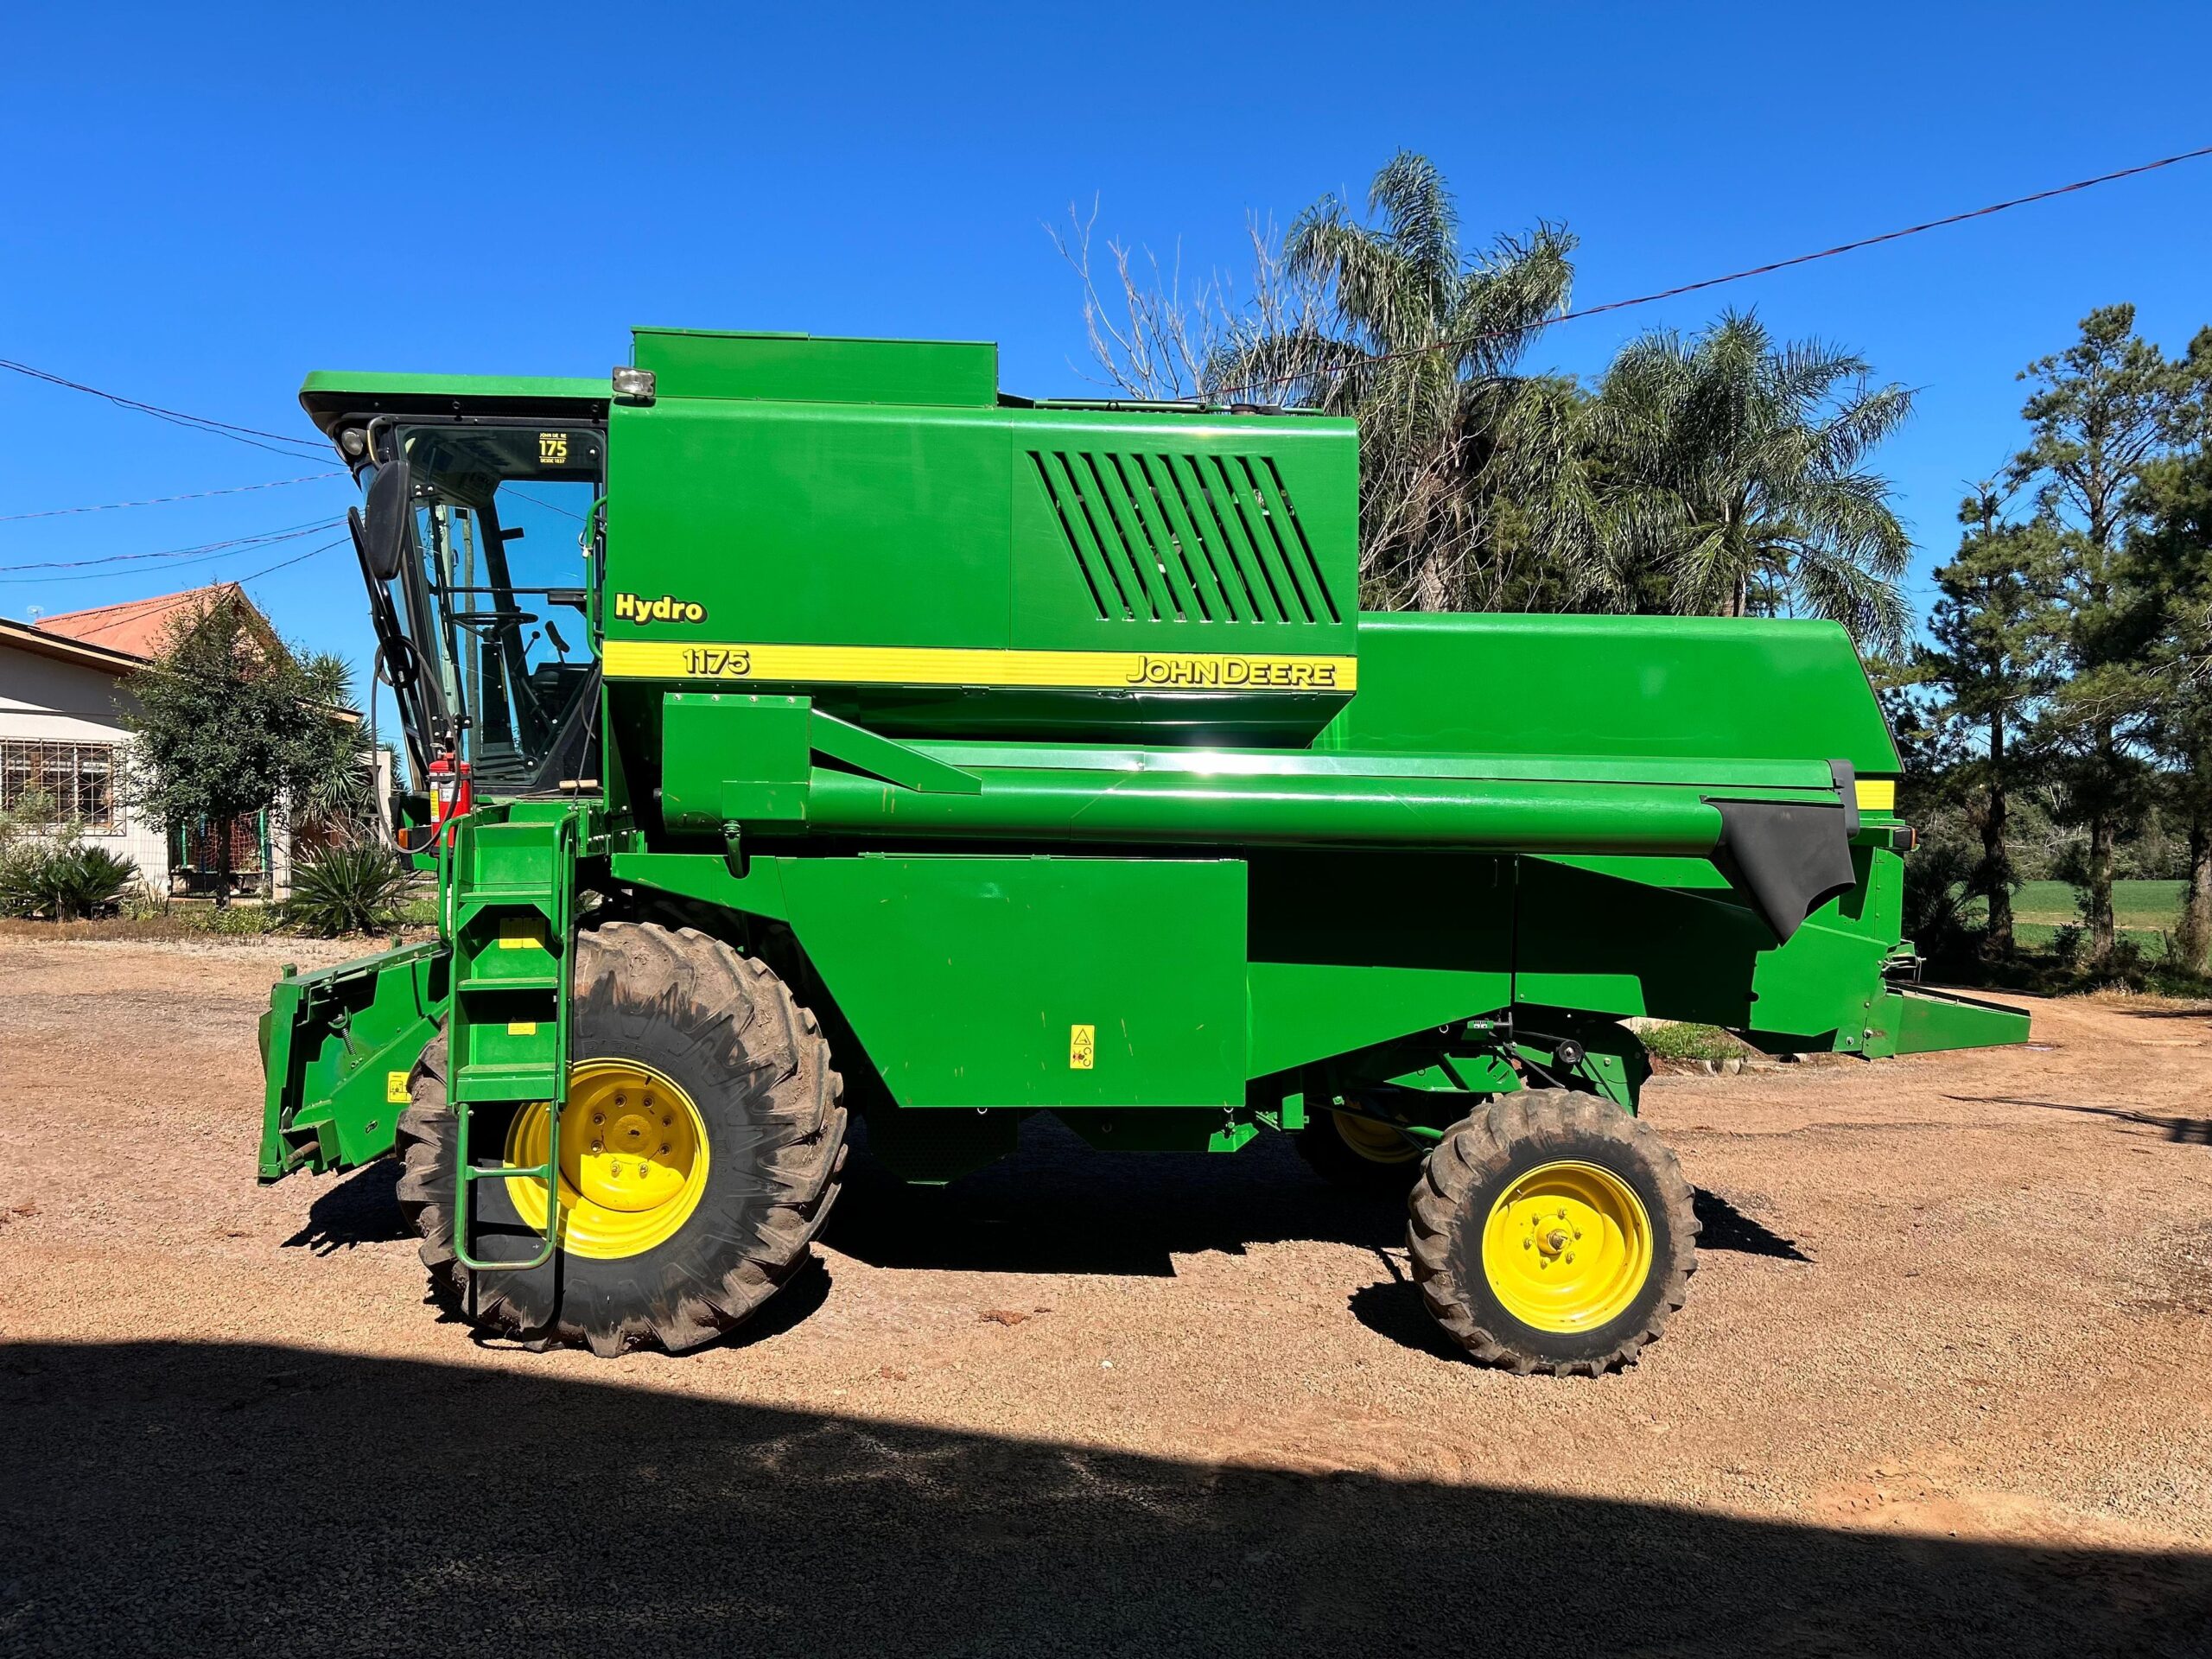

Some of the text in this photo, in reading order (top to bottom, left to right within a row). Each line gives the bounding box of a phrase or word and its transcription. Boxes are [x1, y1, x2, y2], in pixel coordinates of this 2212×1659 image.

[539, 440, 567, 456] 175
[614, 593, 708, 626] Hydro
[683, 649, 750, 674] 1175
[1126, 656, 1335, 686] JOHN DEERE
